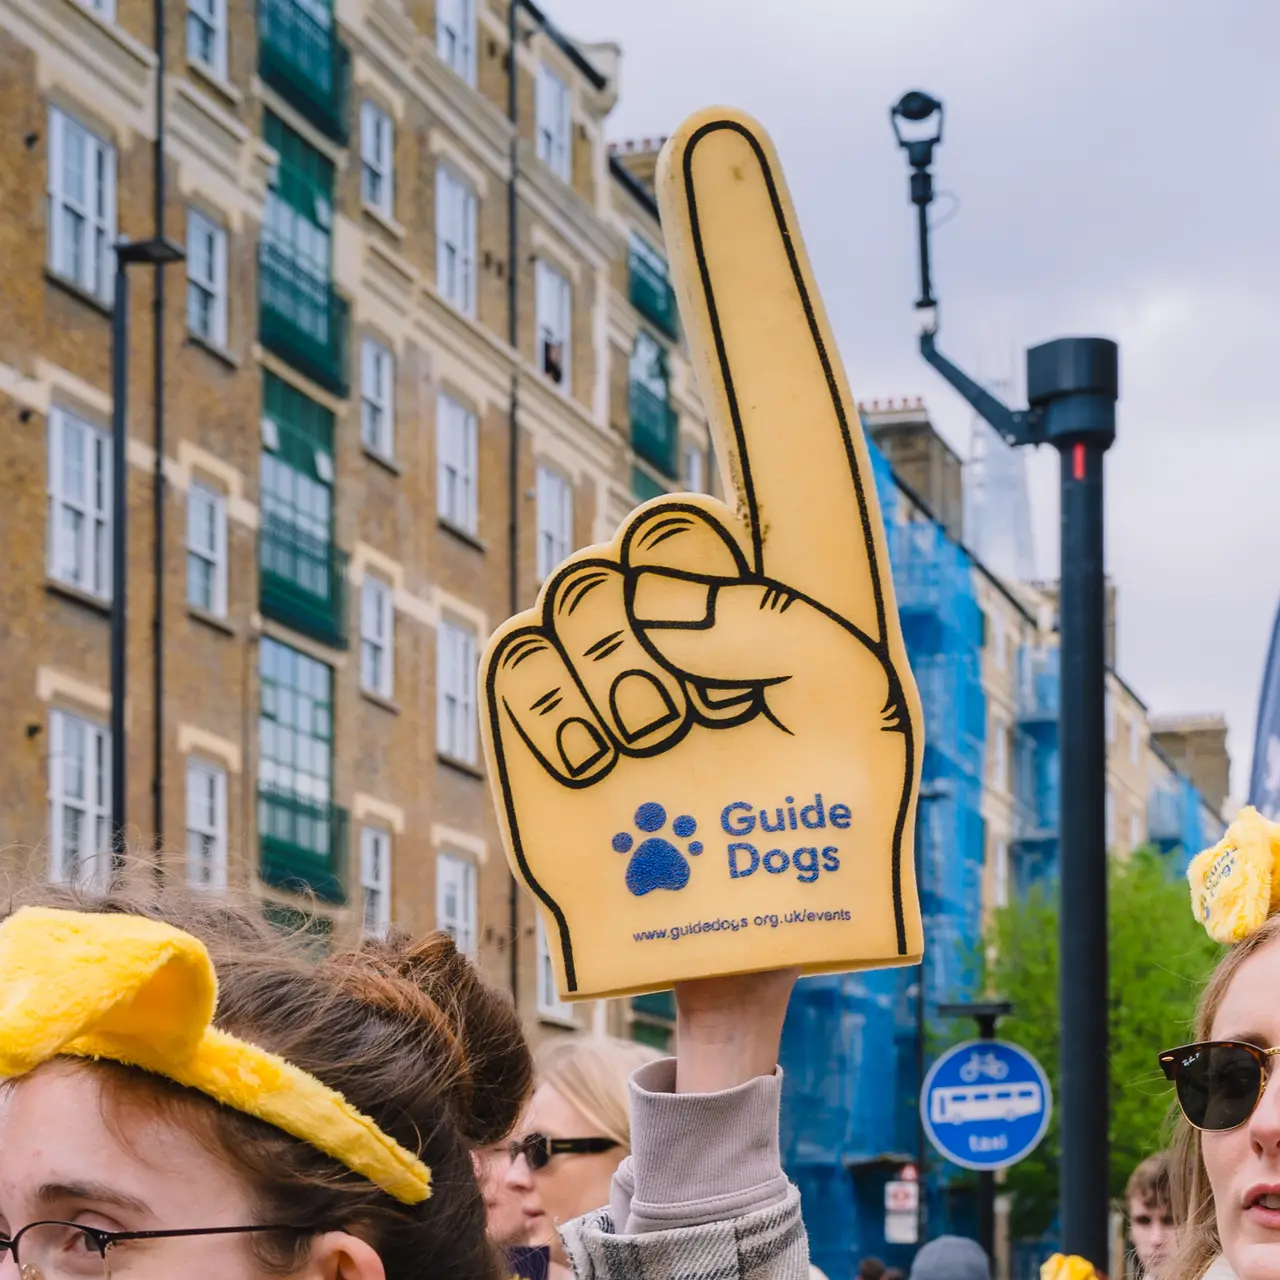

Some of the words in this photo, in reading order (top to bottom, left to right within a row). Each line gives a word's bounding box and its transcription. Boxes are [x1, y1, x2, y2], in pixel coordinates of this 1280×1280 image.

[720, 793, 852, 837] Guide
[727, 842, 840, 884] Dogs
[633, 908, 852, 942] www.guidedogsorg.uk/events
[969, 1133, 1008, 1152] taxi
